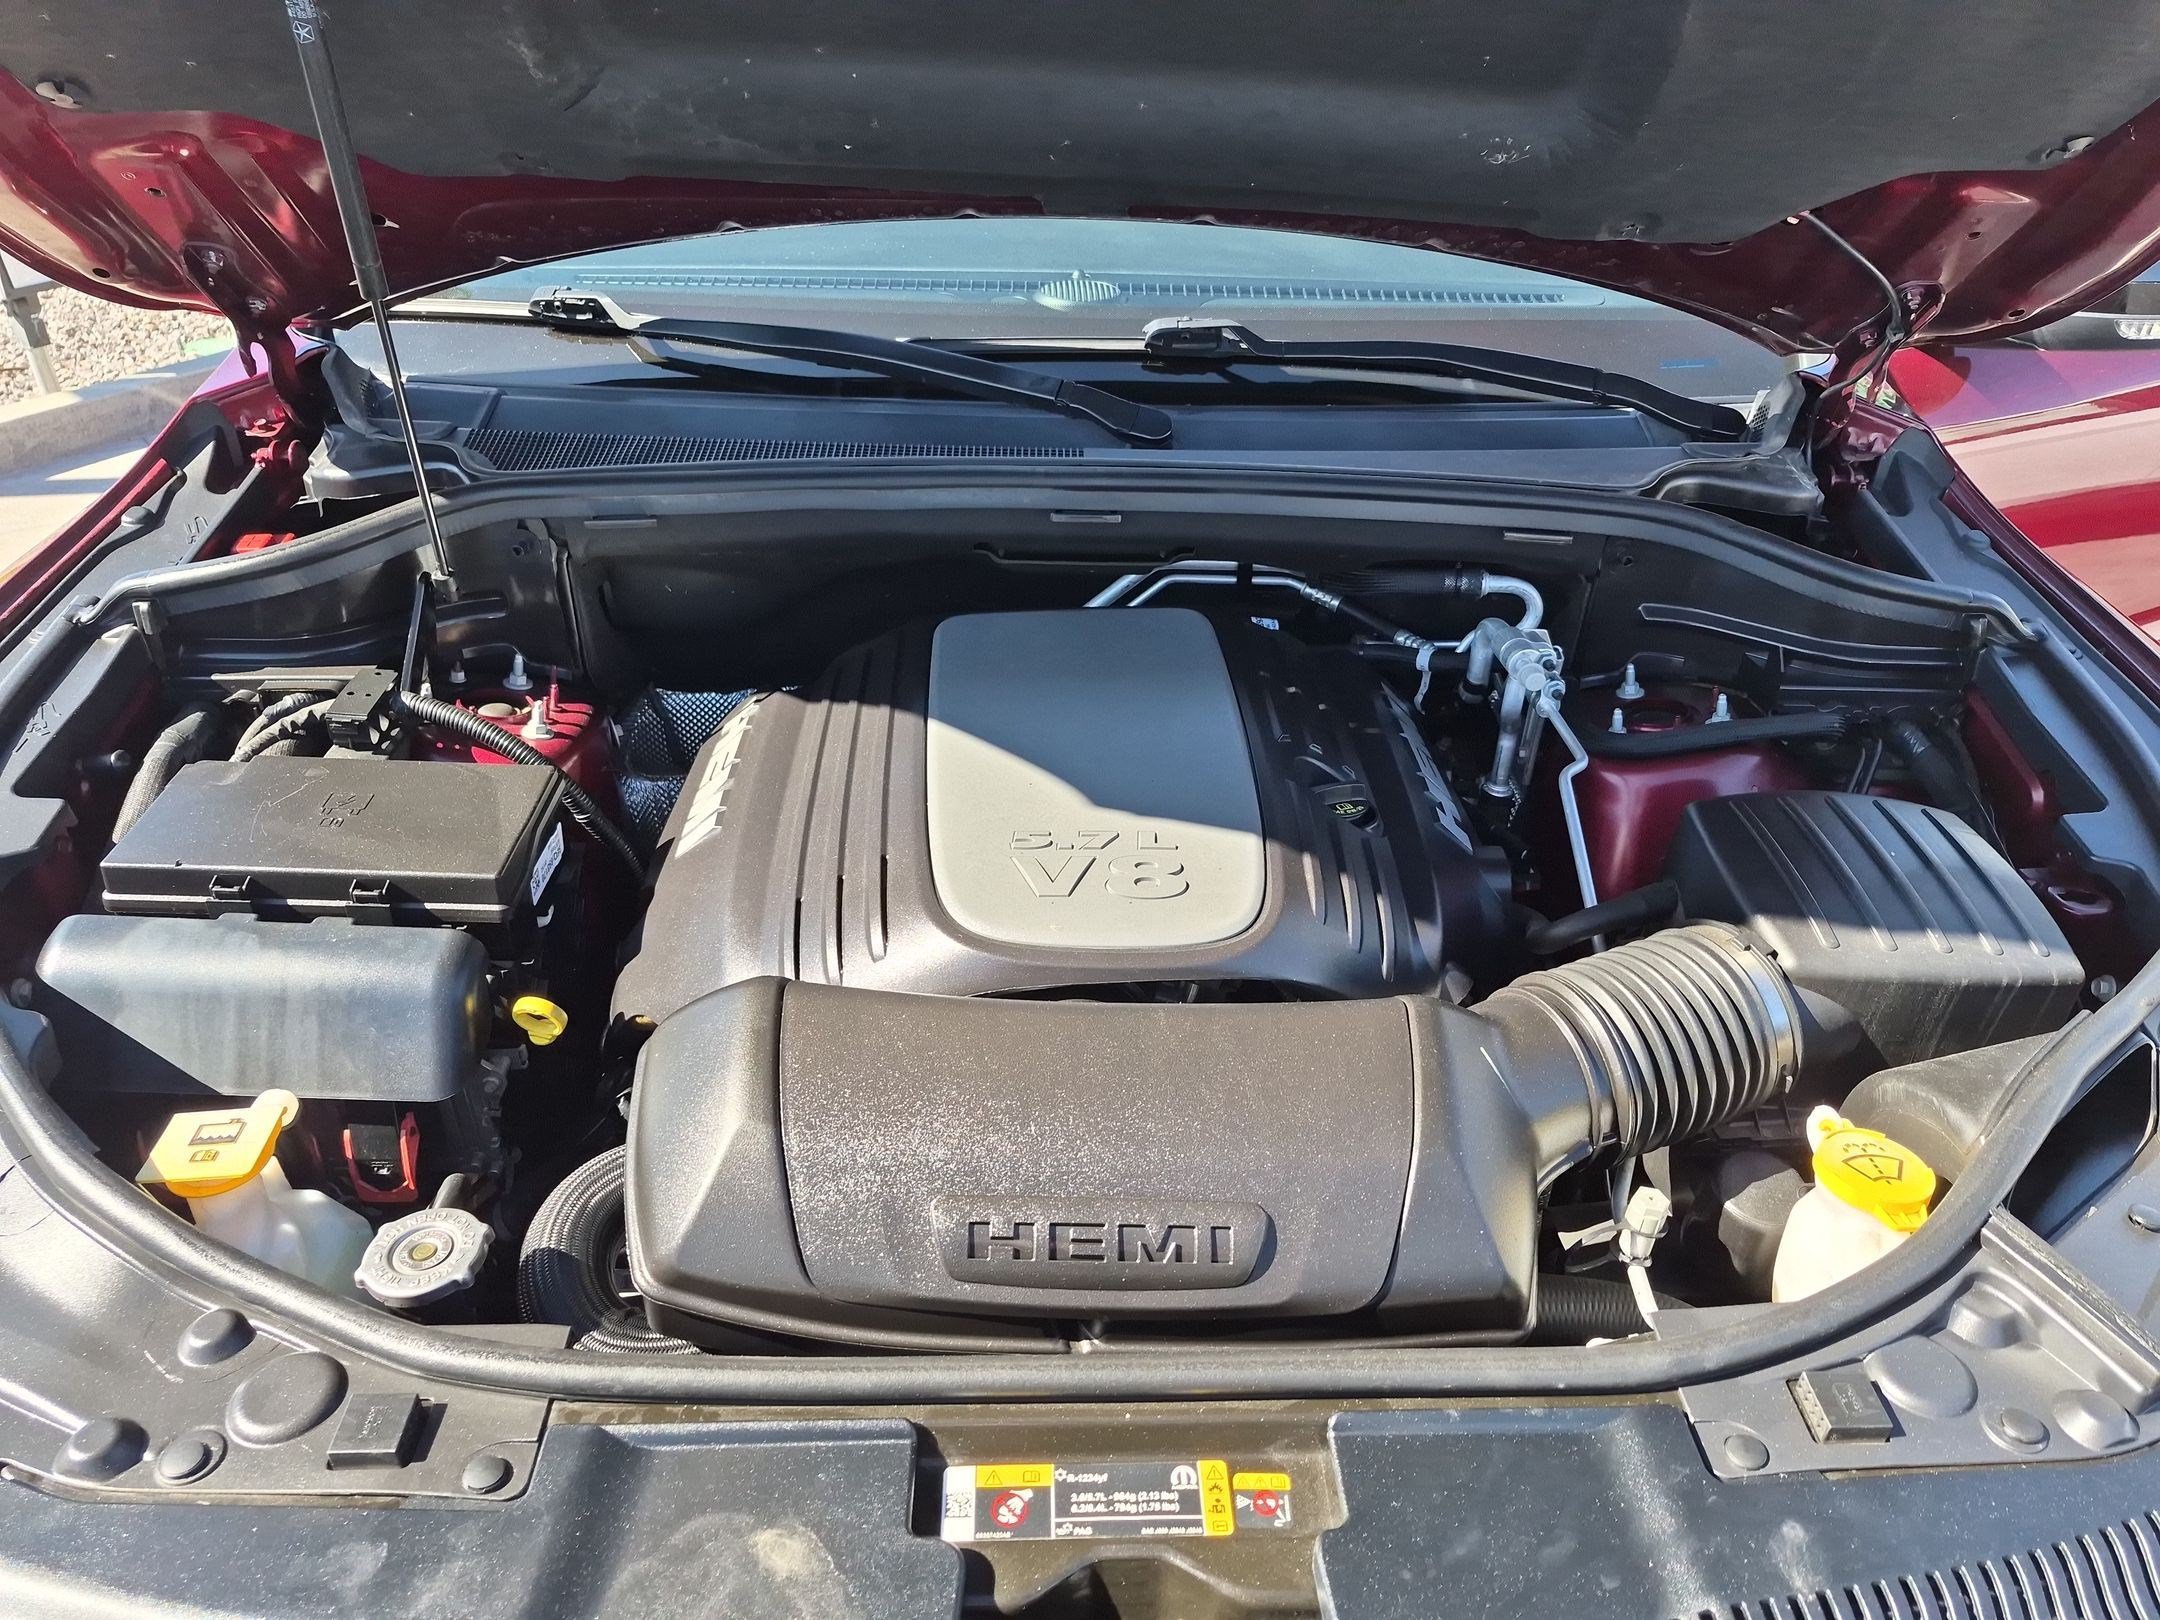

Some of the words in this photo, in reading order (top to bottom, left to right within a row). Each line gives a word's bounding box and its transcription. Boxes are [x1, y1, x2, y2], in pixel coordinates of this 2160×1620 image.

[1009, 830, 1120, 850] 5.7
[1136, 830, 1179, 850] L
[1009, 855, 1190, 900] V8
[406, 1211, 449, 1227] OPEN
[967, 1221, 1235, 1265] HEMI
[407, 1266, 452, 1288] KEEP
[1066, 1473, 1108, 1484] R-1234yf
[1161, 1491, 1179, 1501] lbs)
[1162, 1502, 1180, 1512] lbs)
